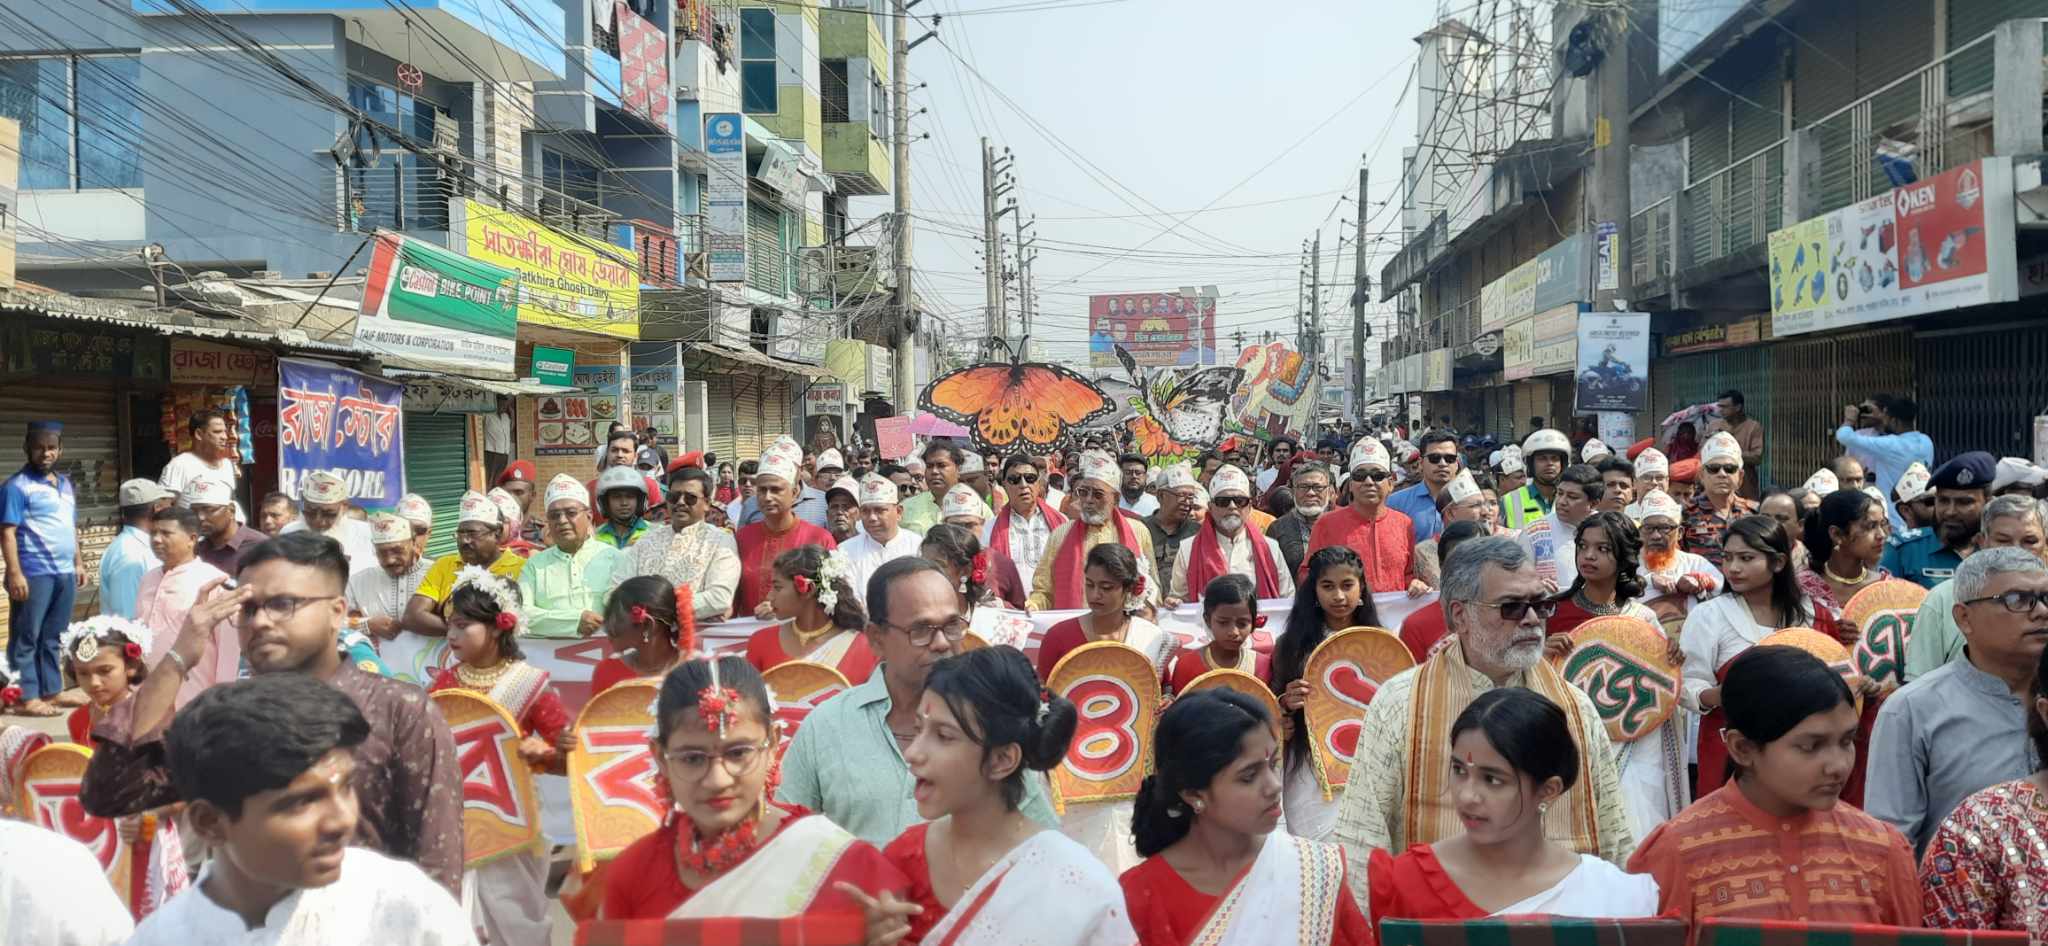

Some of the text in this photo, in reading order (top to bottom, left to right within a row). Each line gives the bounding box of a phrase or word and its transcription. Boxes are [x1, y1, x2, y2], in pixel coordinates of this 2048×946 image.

[464, 287, 493, 305] POINT
[558, 278, 586, 295] Ghosh
[588, 285, 609, 302] Dairy
[376, 331, 405, 345] MOTORS
